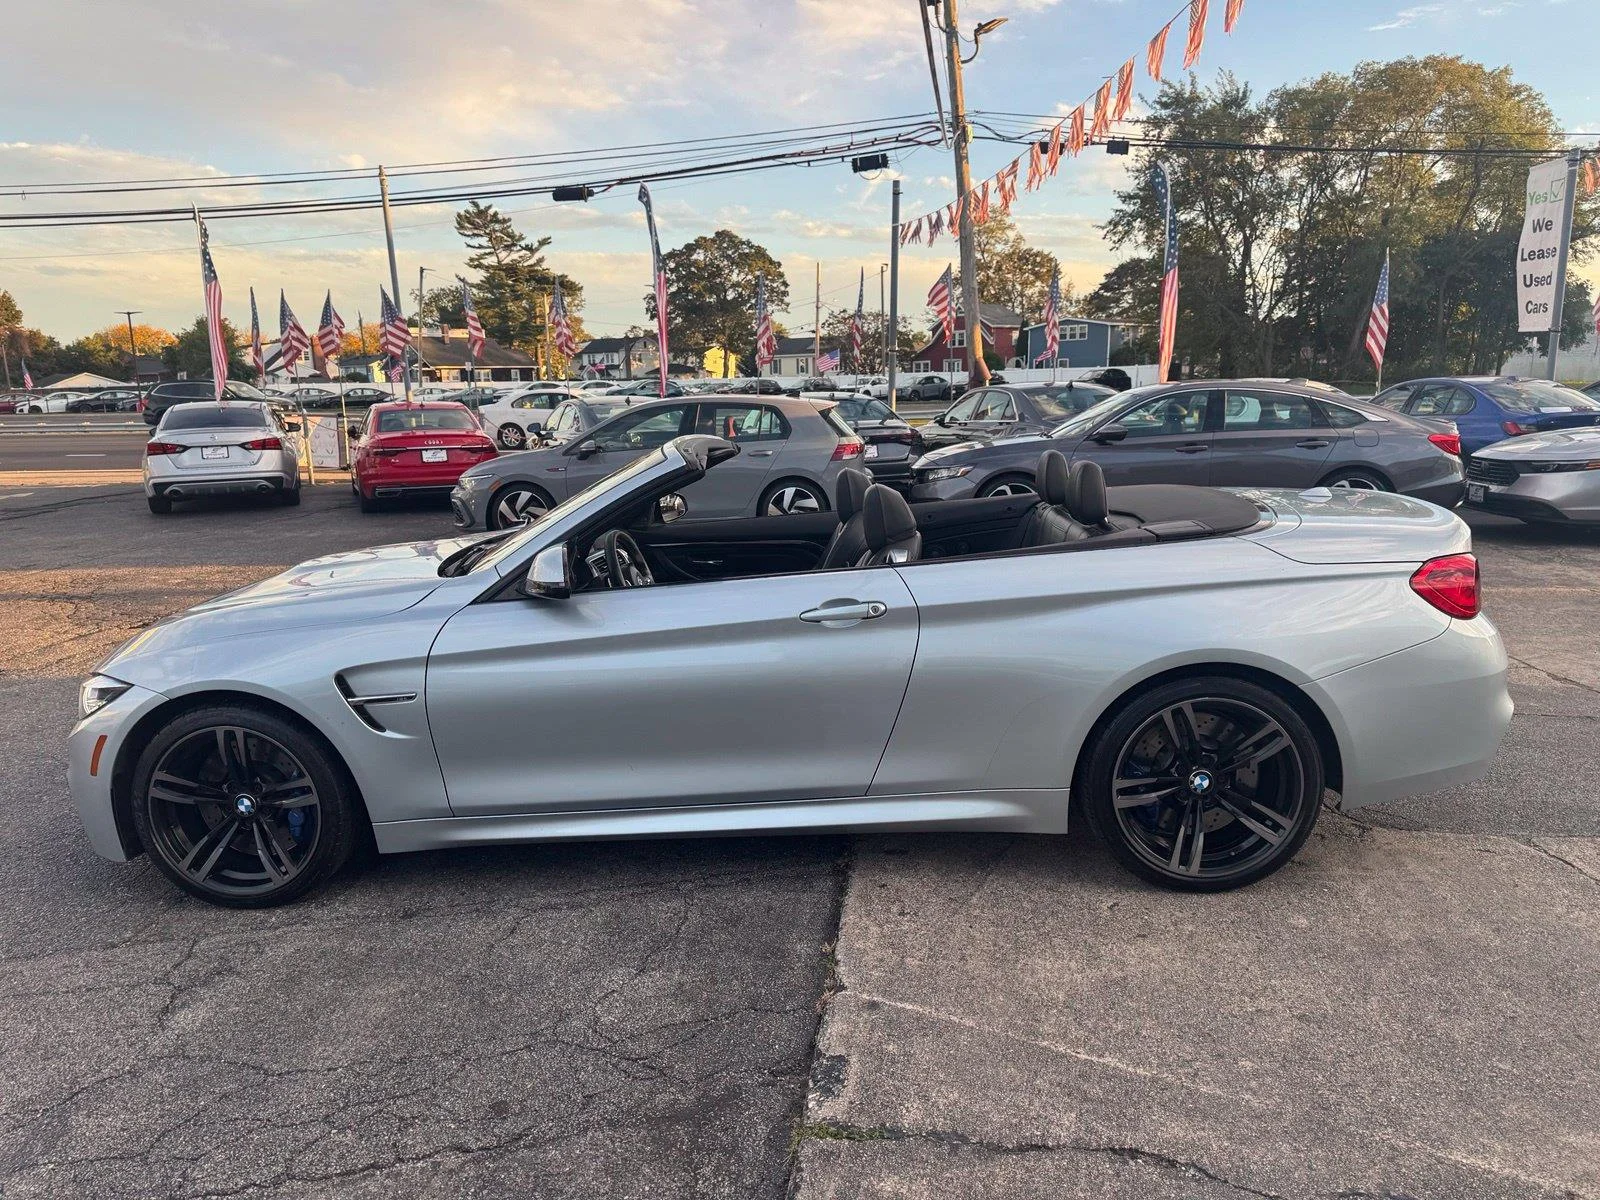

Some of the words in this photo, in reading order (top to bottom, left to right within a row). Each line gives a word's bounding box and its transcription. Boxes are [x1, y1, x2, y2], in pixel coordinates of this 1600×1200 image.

[1528, 191, 1548, 206] Yes
[1532, 217, 1553, 233] We
[1520, 246, 1557, 262] Lease
[1523, 270, 1552, 288] Used
[1525, 300, 1548, 314] Cars
